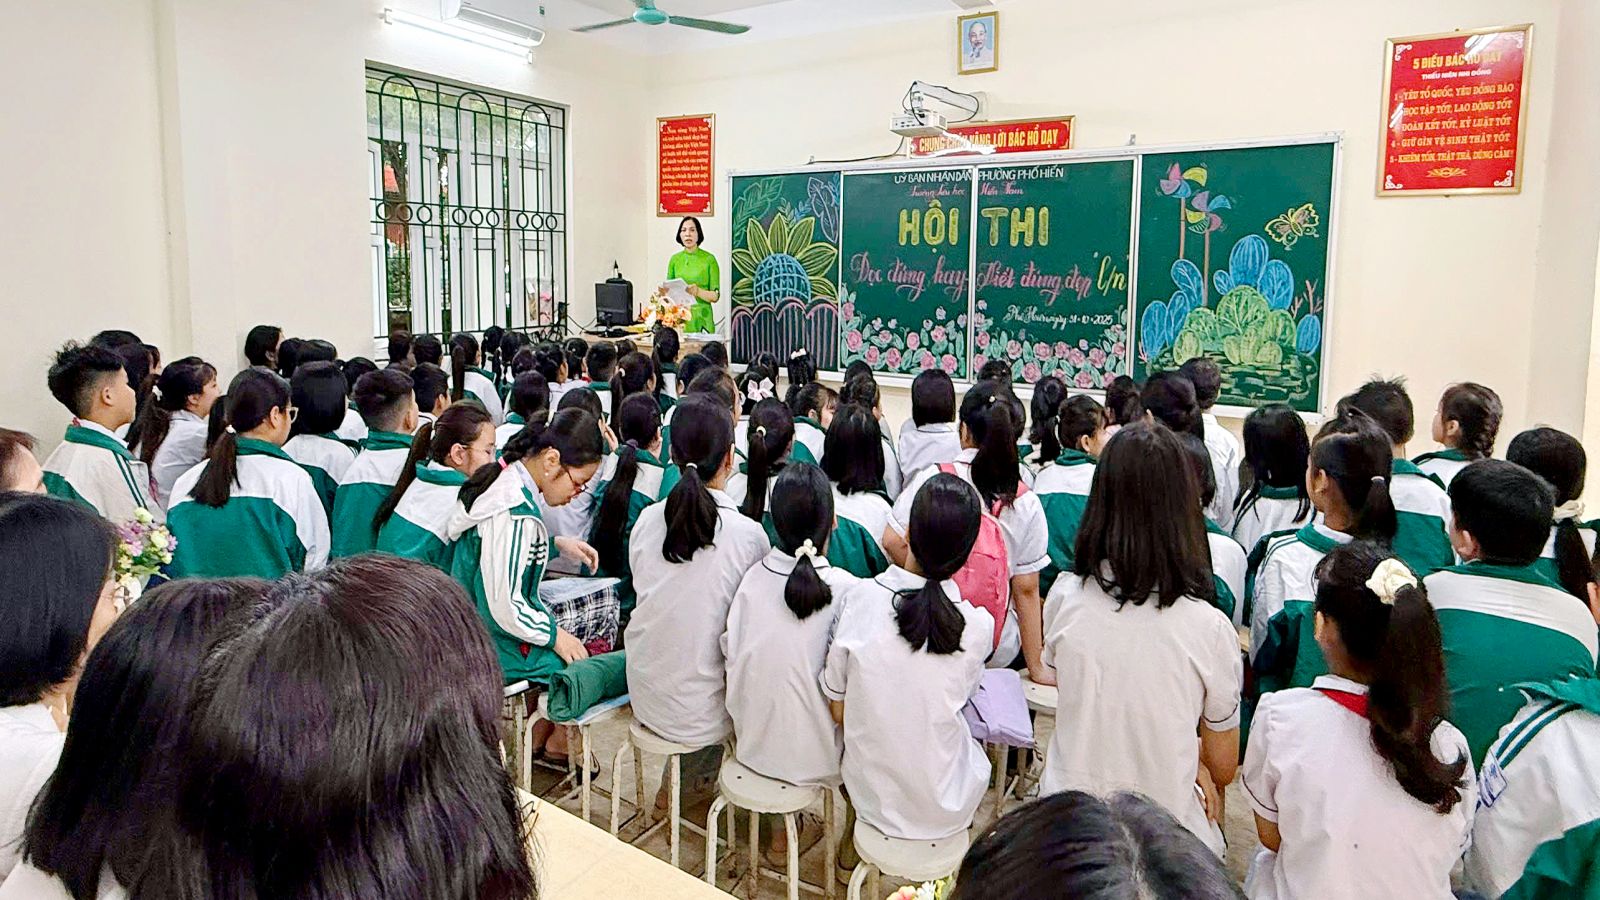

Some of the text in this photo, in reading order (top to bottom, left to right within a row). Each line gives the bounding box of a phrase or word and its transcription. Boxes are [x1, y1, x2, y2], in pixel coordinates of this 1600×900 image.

[1413, 58, 1420, 70] 5
[1445, 52, 1464, 67] BÁC
[1008, 127, 1026, 147] BÁC
[1027, 123, 1040, 146] HỒ
[1040, 128, 1059, 149] DẠY
[908, 172, 926, 183] BAN
[898, 198, 1049, 253] HỘI THI
